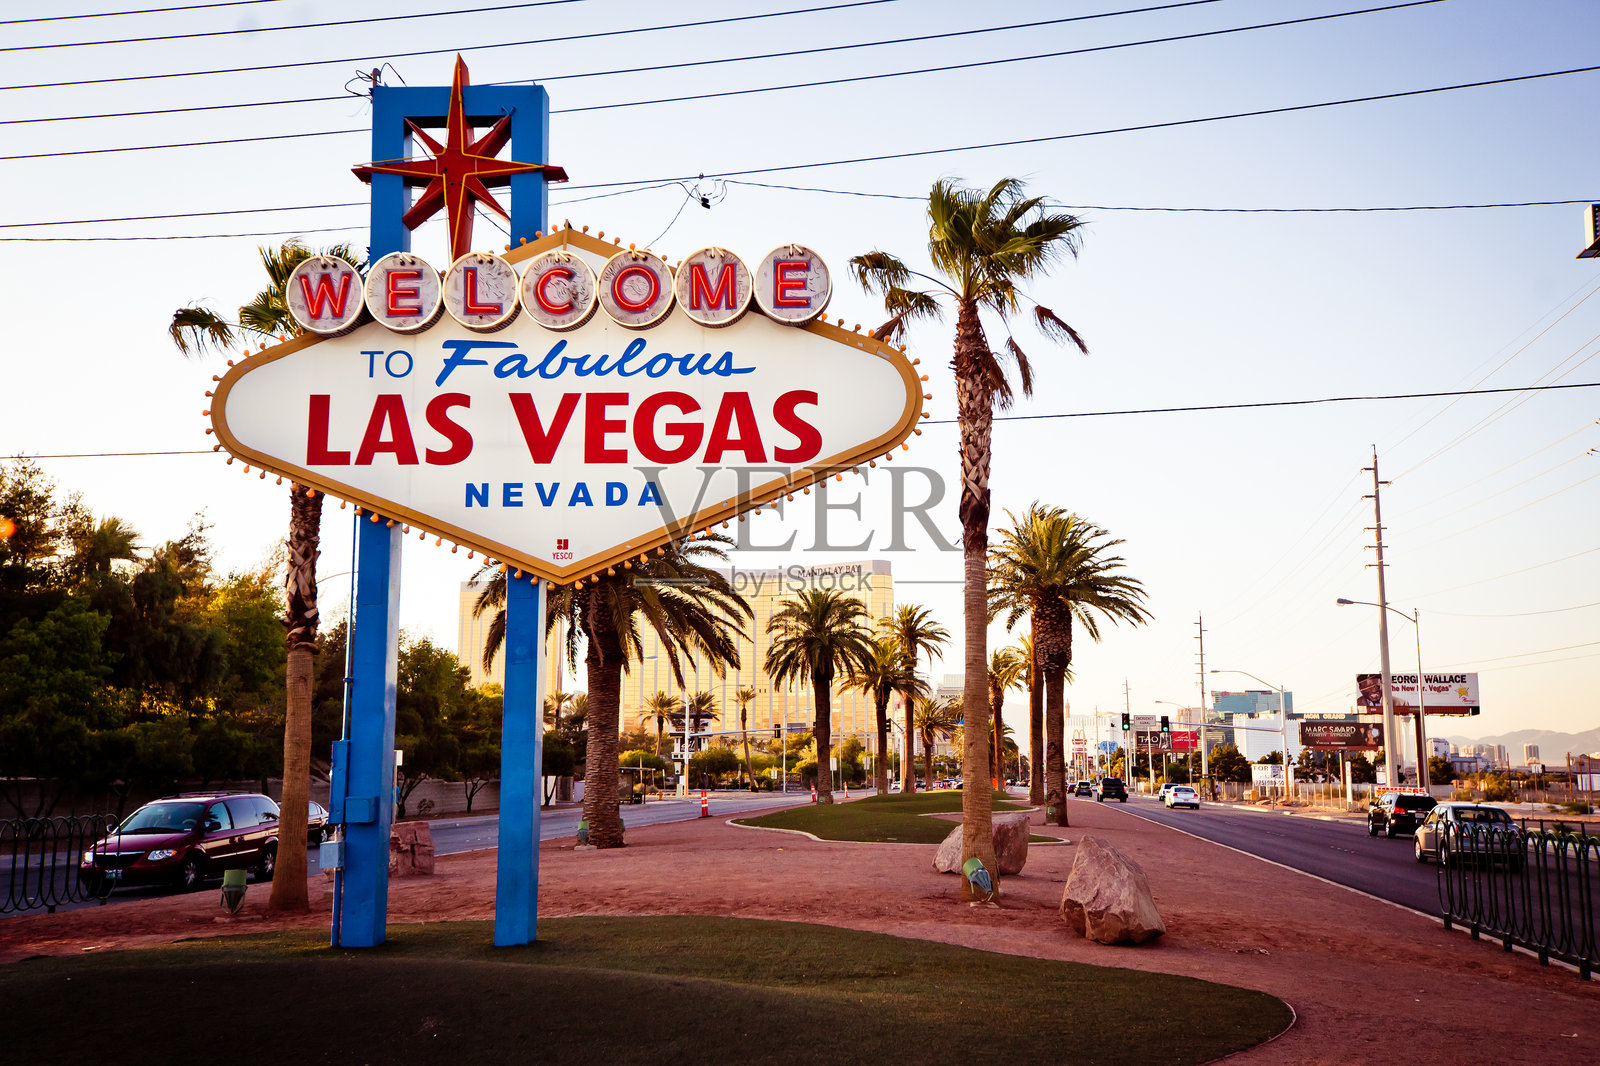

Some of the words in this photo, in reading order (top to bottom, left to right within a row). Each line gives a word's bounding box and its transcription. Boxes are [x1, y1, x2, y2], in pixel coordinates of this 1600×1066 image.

[299, 259, 812, 320] WELCOME
[360, 350, 414, 378] TO
[435, 337, 757, 388] Fabulous
[307, 393, 473, 466] LAS
[509, 390, 822, 466] VEGAS
[465, 481, 664, 508] NEVADA
[552, 552, 574, 560] YESCO
[797, 566, 843, 578] MANDALAY
[845, 564, 862, 574] BAY
[1423, 674, 1467, 684] WALLACE
